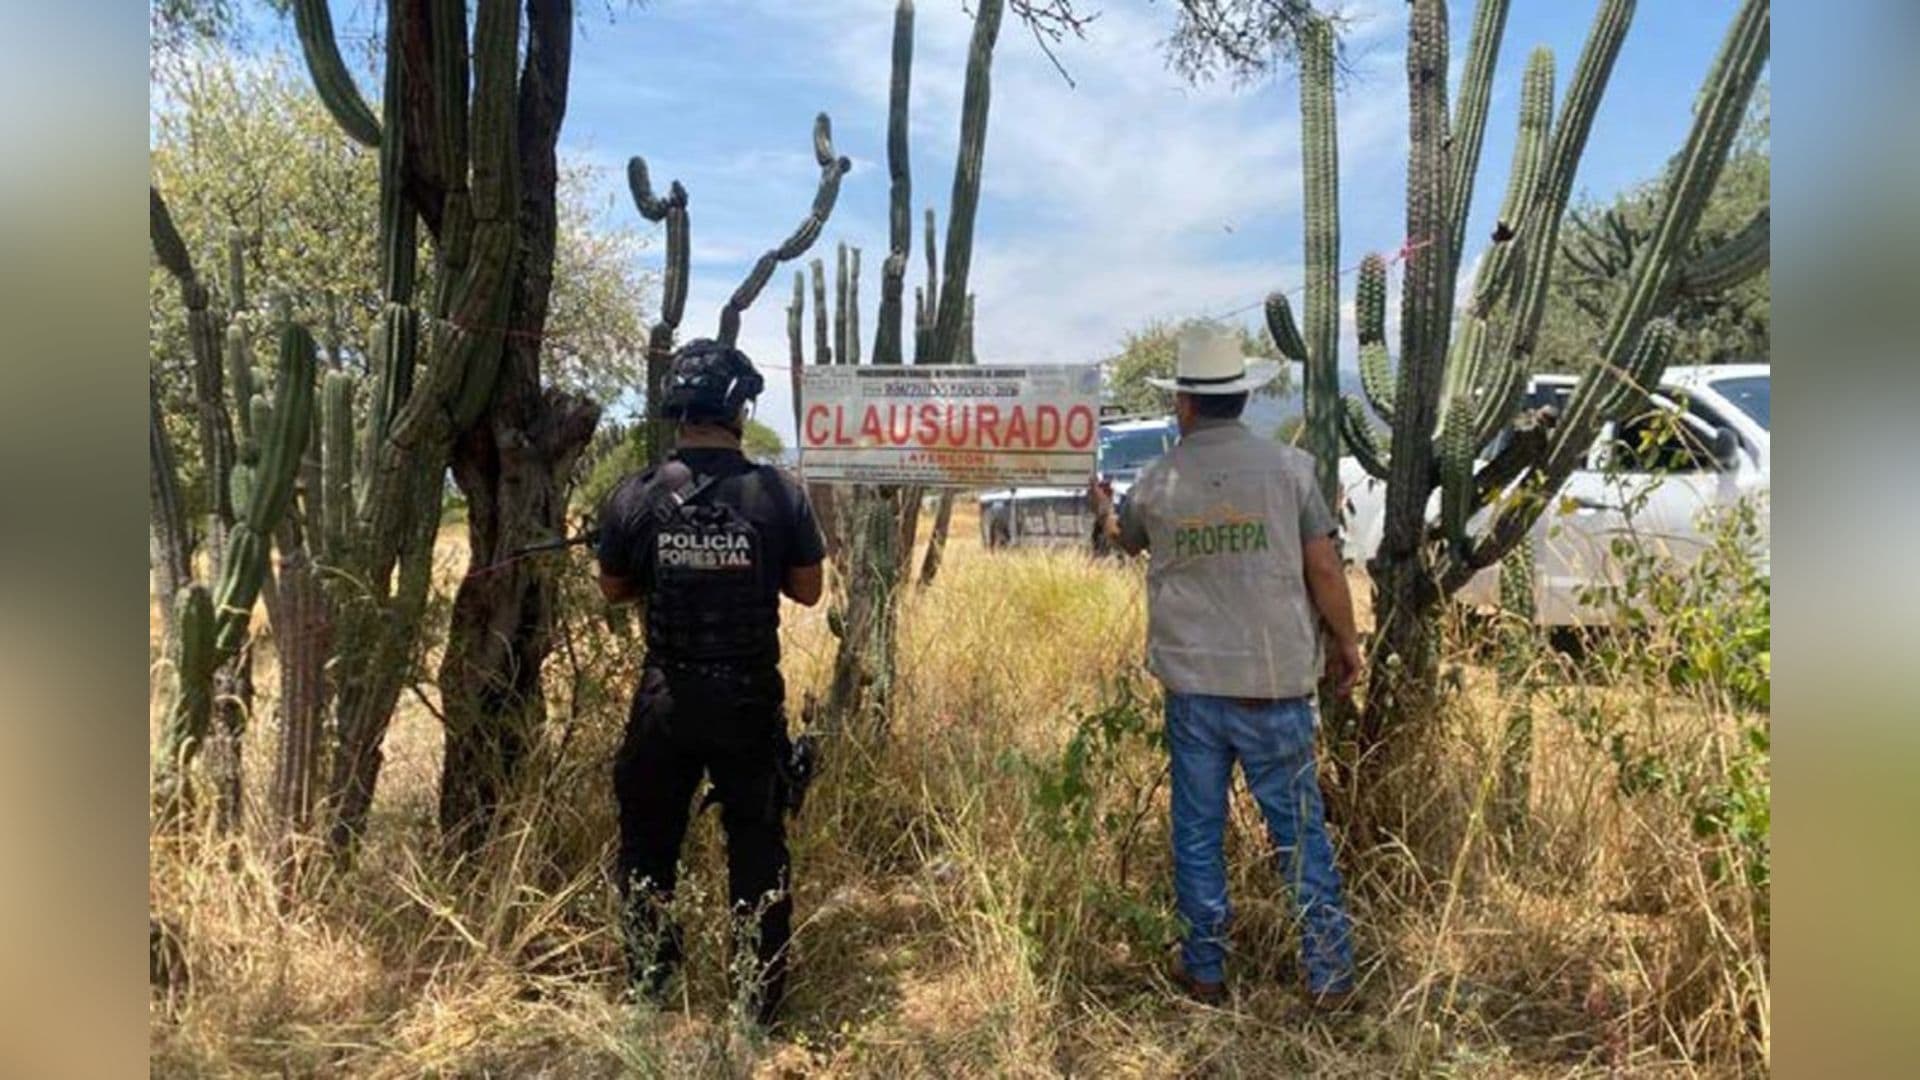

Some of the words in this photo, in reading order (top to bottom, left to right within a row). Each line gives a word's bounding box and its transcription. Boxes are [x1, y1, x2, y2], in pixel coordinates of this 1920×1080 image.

[805, 404, 1095, 450] CLAUSURADO
[1174, 522, 1269, 556] PROFEPA
[658, 550, 752, 568] FORESTAL
